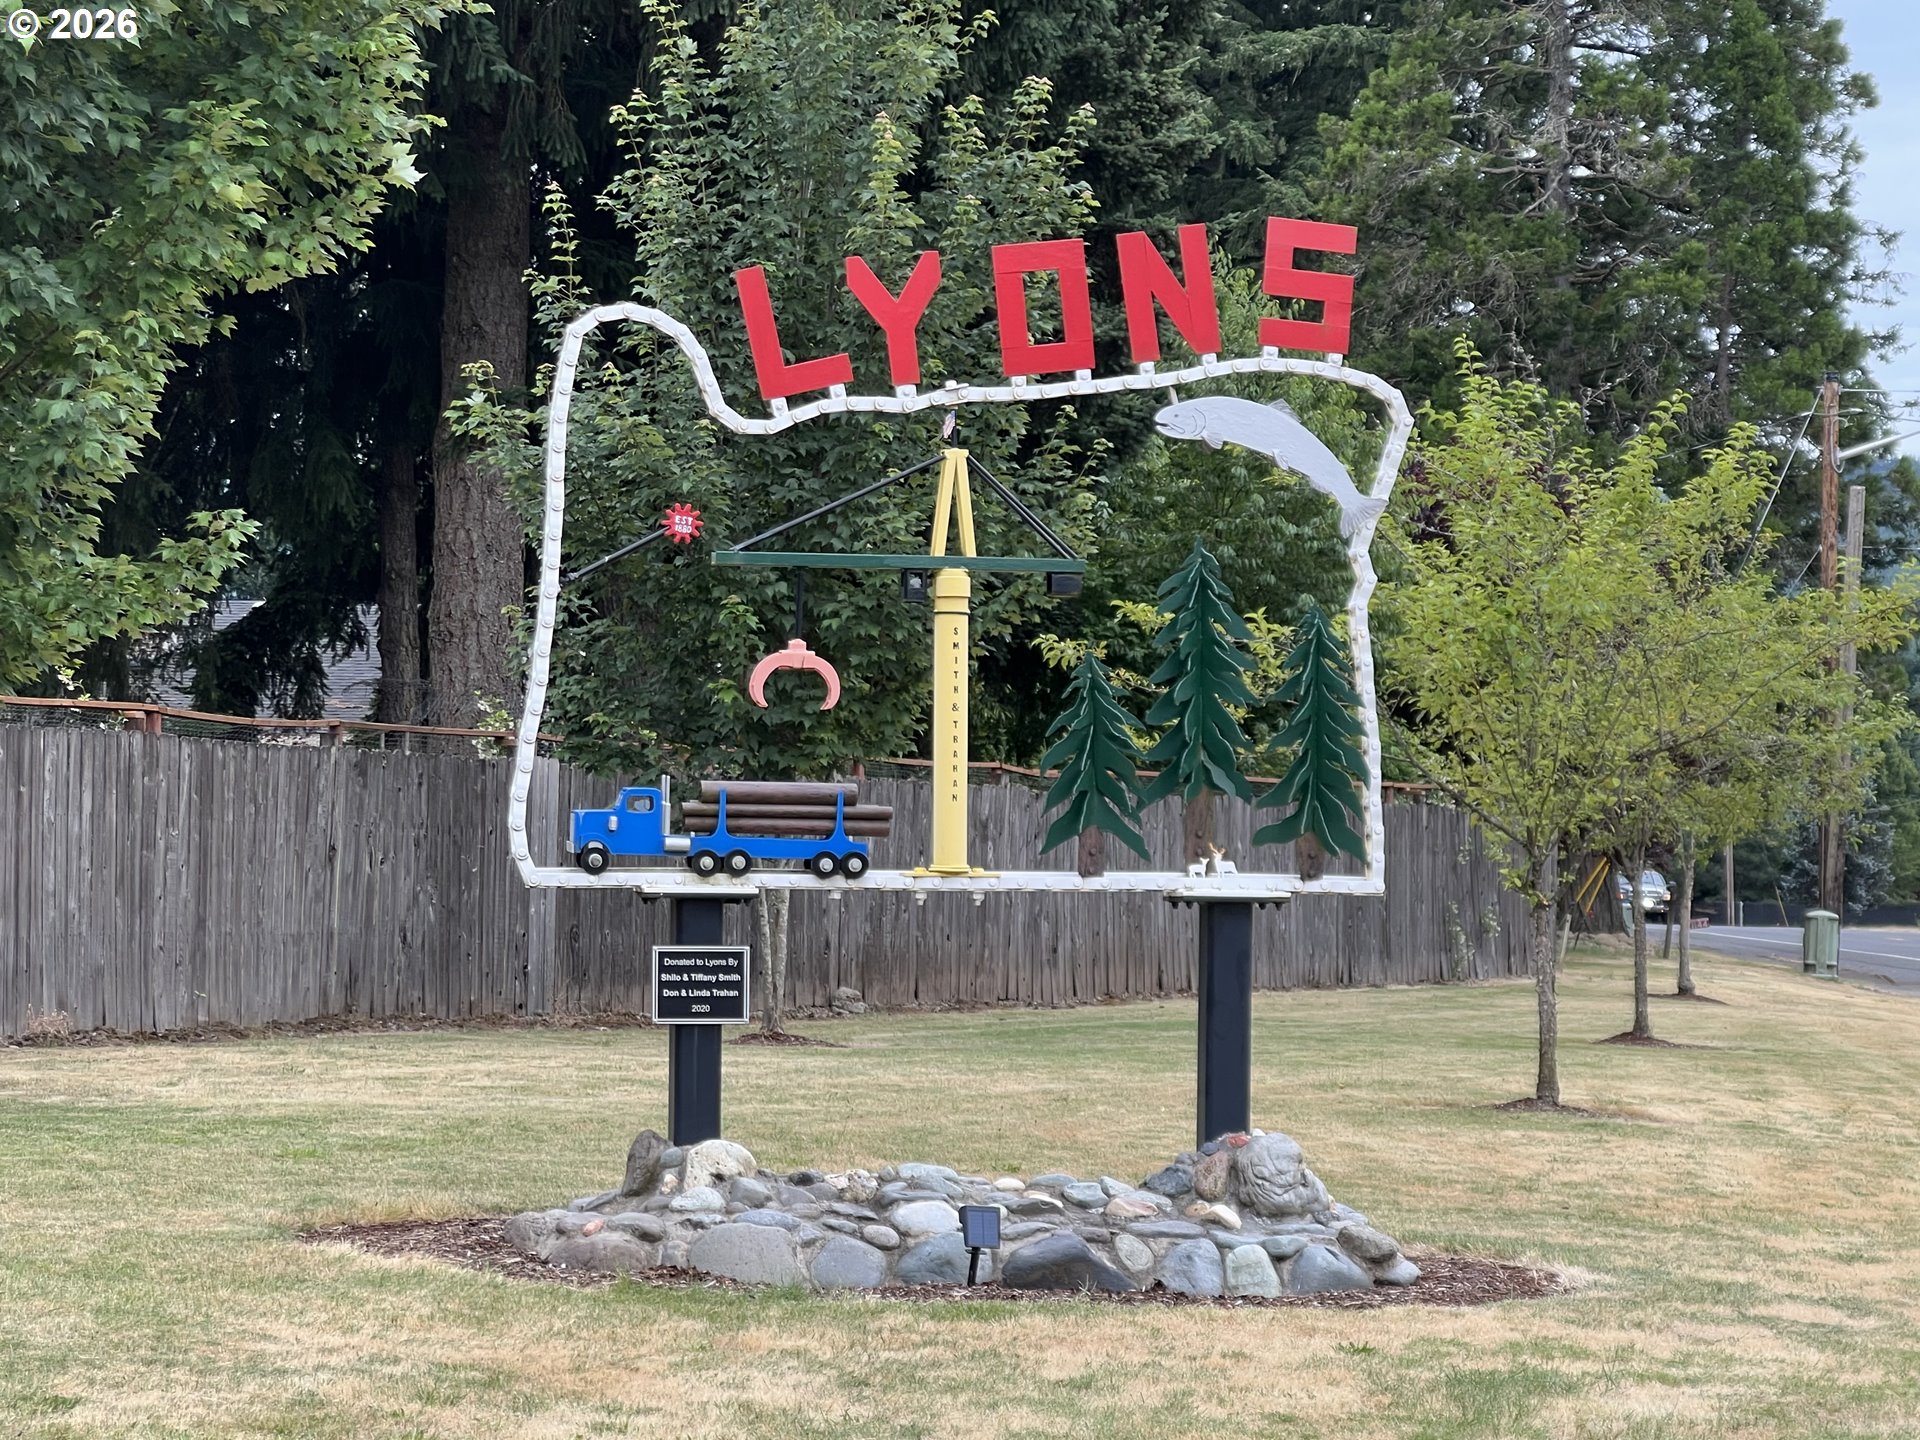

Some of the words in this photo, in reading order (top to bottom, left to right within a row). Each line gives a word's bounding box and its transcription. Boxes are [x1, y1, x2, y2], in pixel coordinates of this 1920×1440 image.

[735, 216, 1358, 400] LYONS
[675, 515, 693, 525] EST
[952, 627, 960, 694] SMITH
[951, 703, 960, 712] &
[664, 958, 695, 966] Donated
[696, 958, 704, 966] to
[705, 958, 727, 967] Lyons
[728, 958, 738, 967] By
[661, 973, 681, 981] Shilo
[682, 973, 689, 981] &
[690, 973, 717, 983] Tiffany
[718, 973, 741, 981] Smith
[663, 989, 679, 997] Don
[681, 989, 687, 997] &
[689, 989, 710, 997] Linda
[712, 989, 739, 997] Trahan
[691, 1004, 711, 1013] 2020
